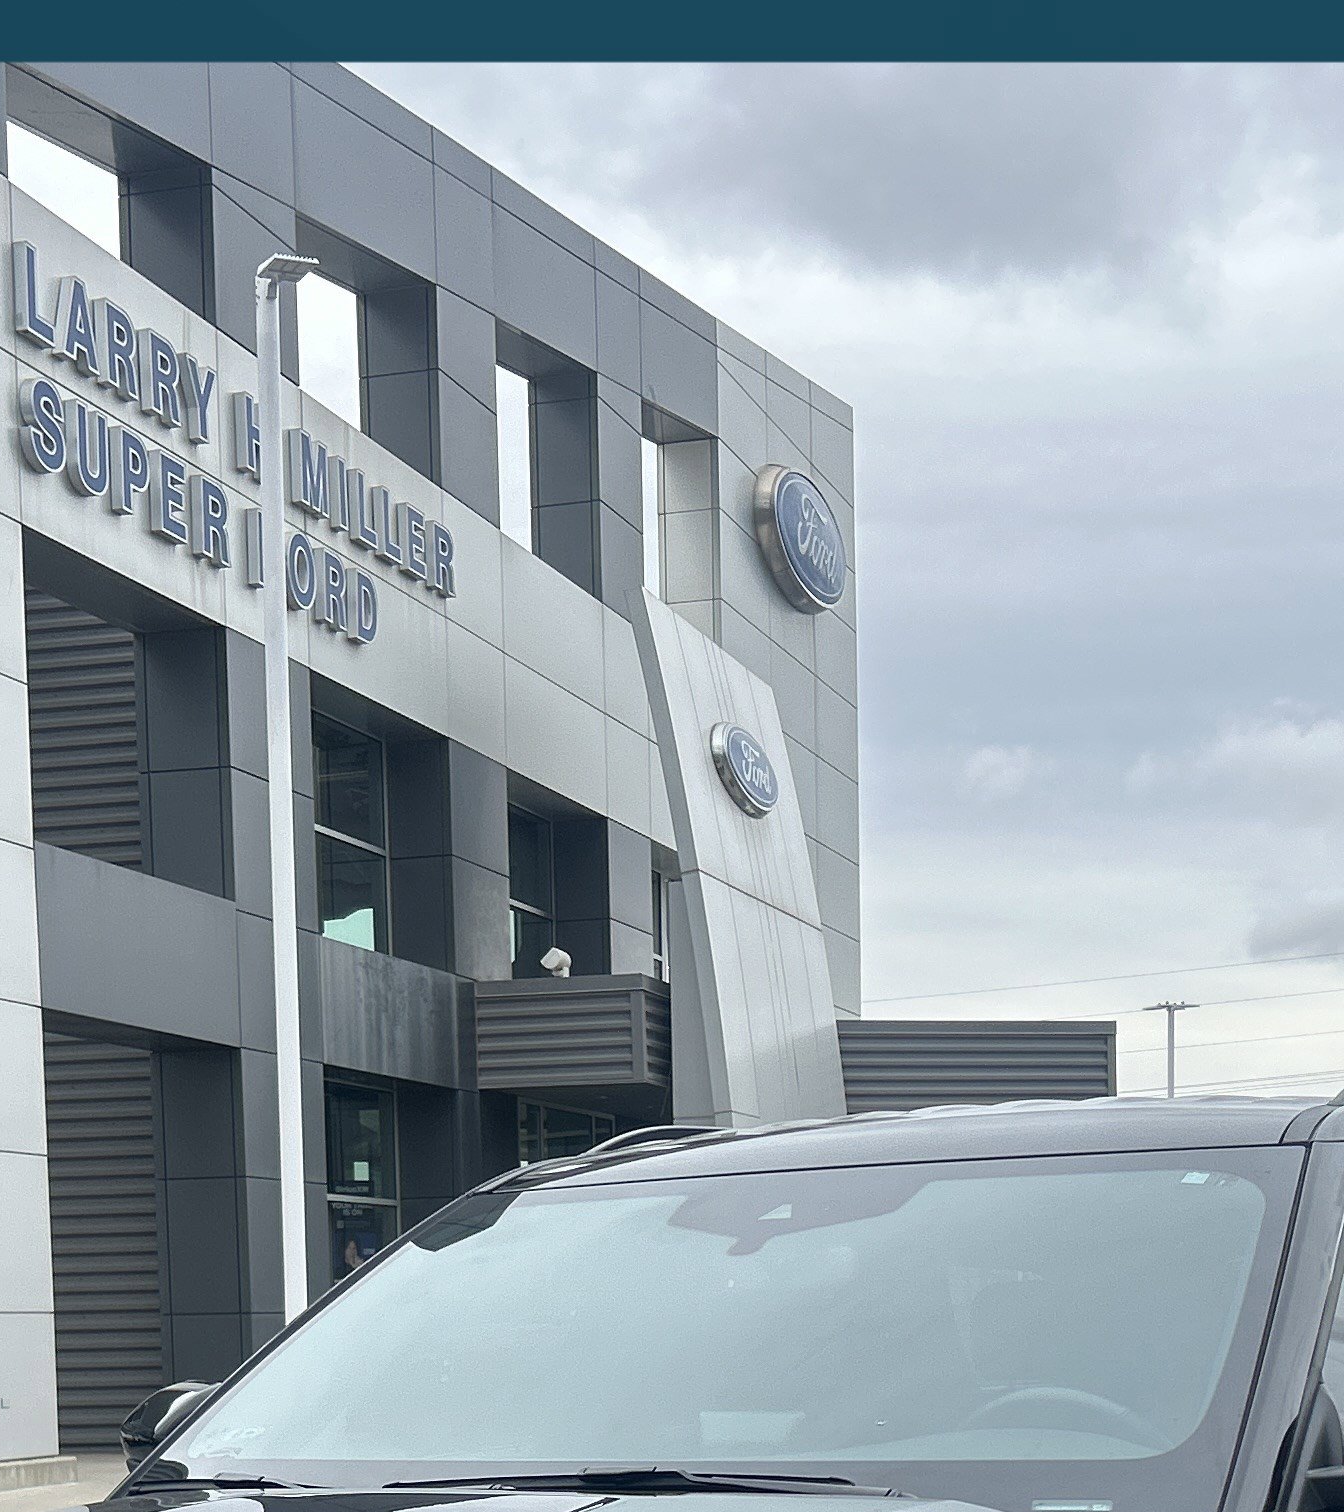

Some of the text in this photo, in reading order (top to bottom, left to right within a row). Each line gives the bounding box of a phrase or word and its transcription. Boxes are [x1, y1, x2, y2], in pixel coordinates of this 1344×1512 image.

[12, 240, 217, 445] LARRY
[288, 427, 456, 599] MILLER
[18, 376, 379, 645] SUPER ORD
